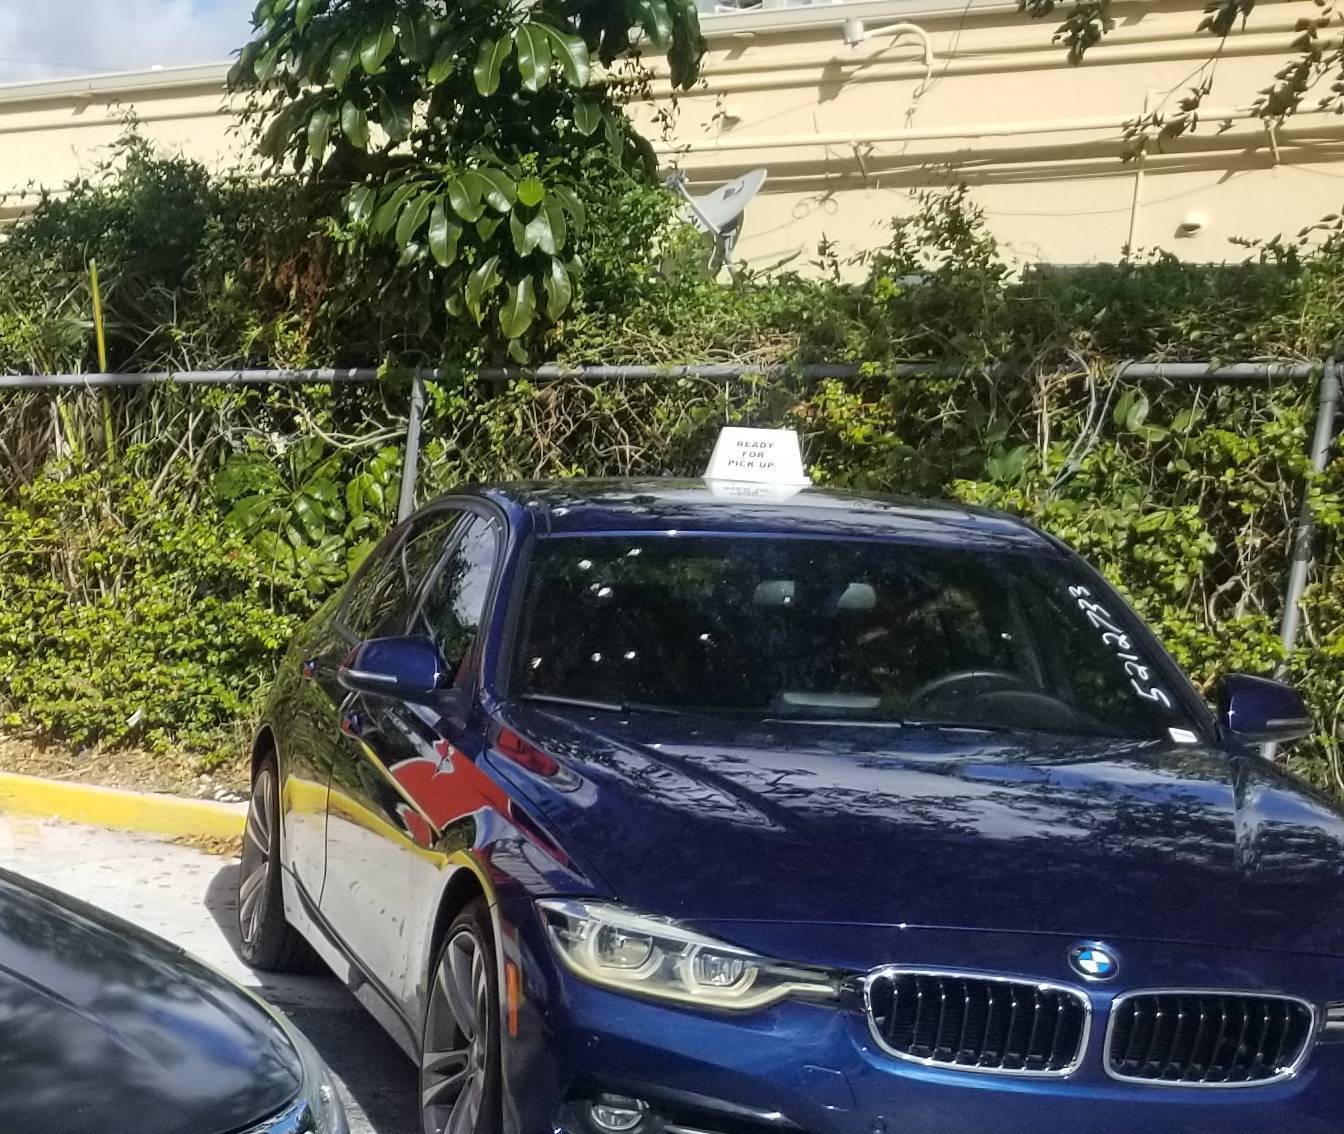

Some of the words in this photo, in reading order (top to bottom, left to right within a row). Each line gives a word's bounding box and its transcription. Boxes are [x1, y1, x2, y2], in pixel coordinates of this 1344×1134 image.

[736, 440, 774, 448] READY
[727, 459, 754, 468] PICK
[1068, 585, 1171, 708] 5212733
